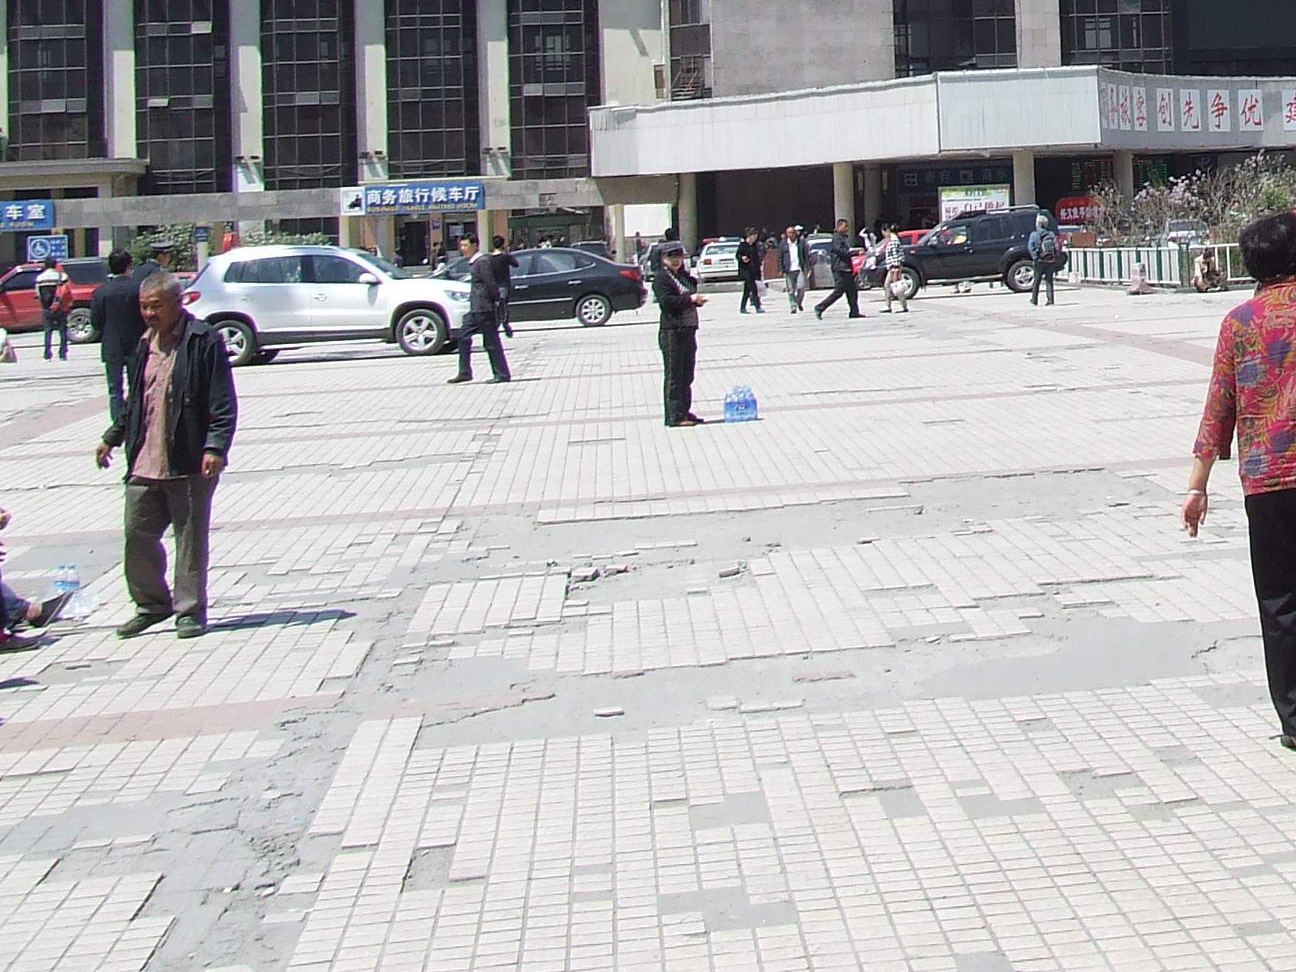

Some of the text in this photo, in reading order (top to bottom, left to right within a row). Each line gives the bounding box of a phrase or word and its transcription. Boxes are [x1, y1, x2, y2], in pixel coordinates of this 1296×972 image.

[367, 186, 480, 205] 商务旅行候车厅
